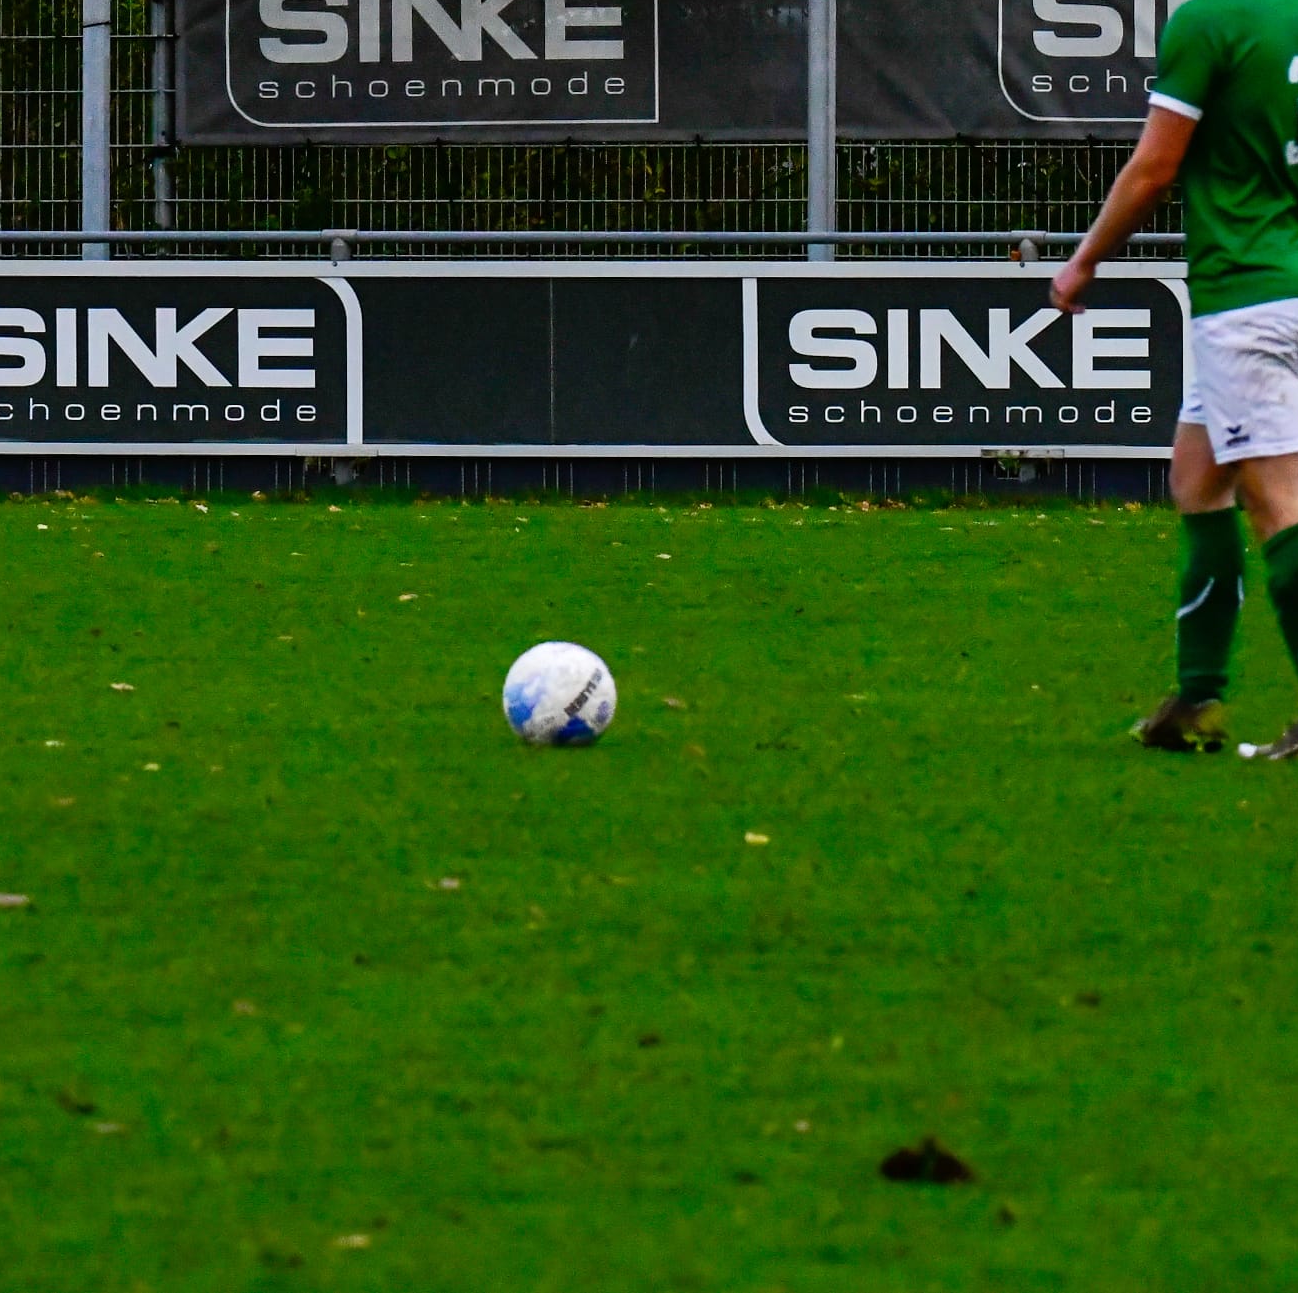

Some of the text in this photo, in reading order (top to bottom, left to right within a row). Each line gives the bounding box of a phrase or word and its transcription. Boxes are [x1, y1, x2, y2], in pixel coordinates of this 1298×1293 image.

[259, 72, 625, 99] schoenmode
[789, 309, 1151, 389] SINKE
[789, 400, 1152, 423] schoenmode
